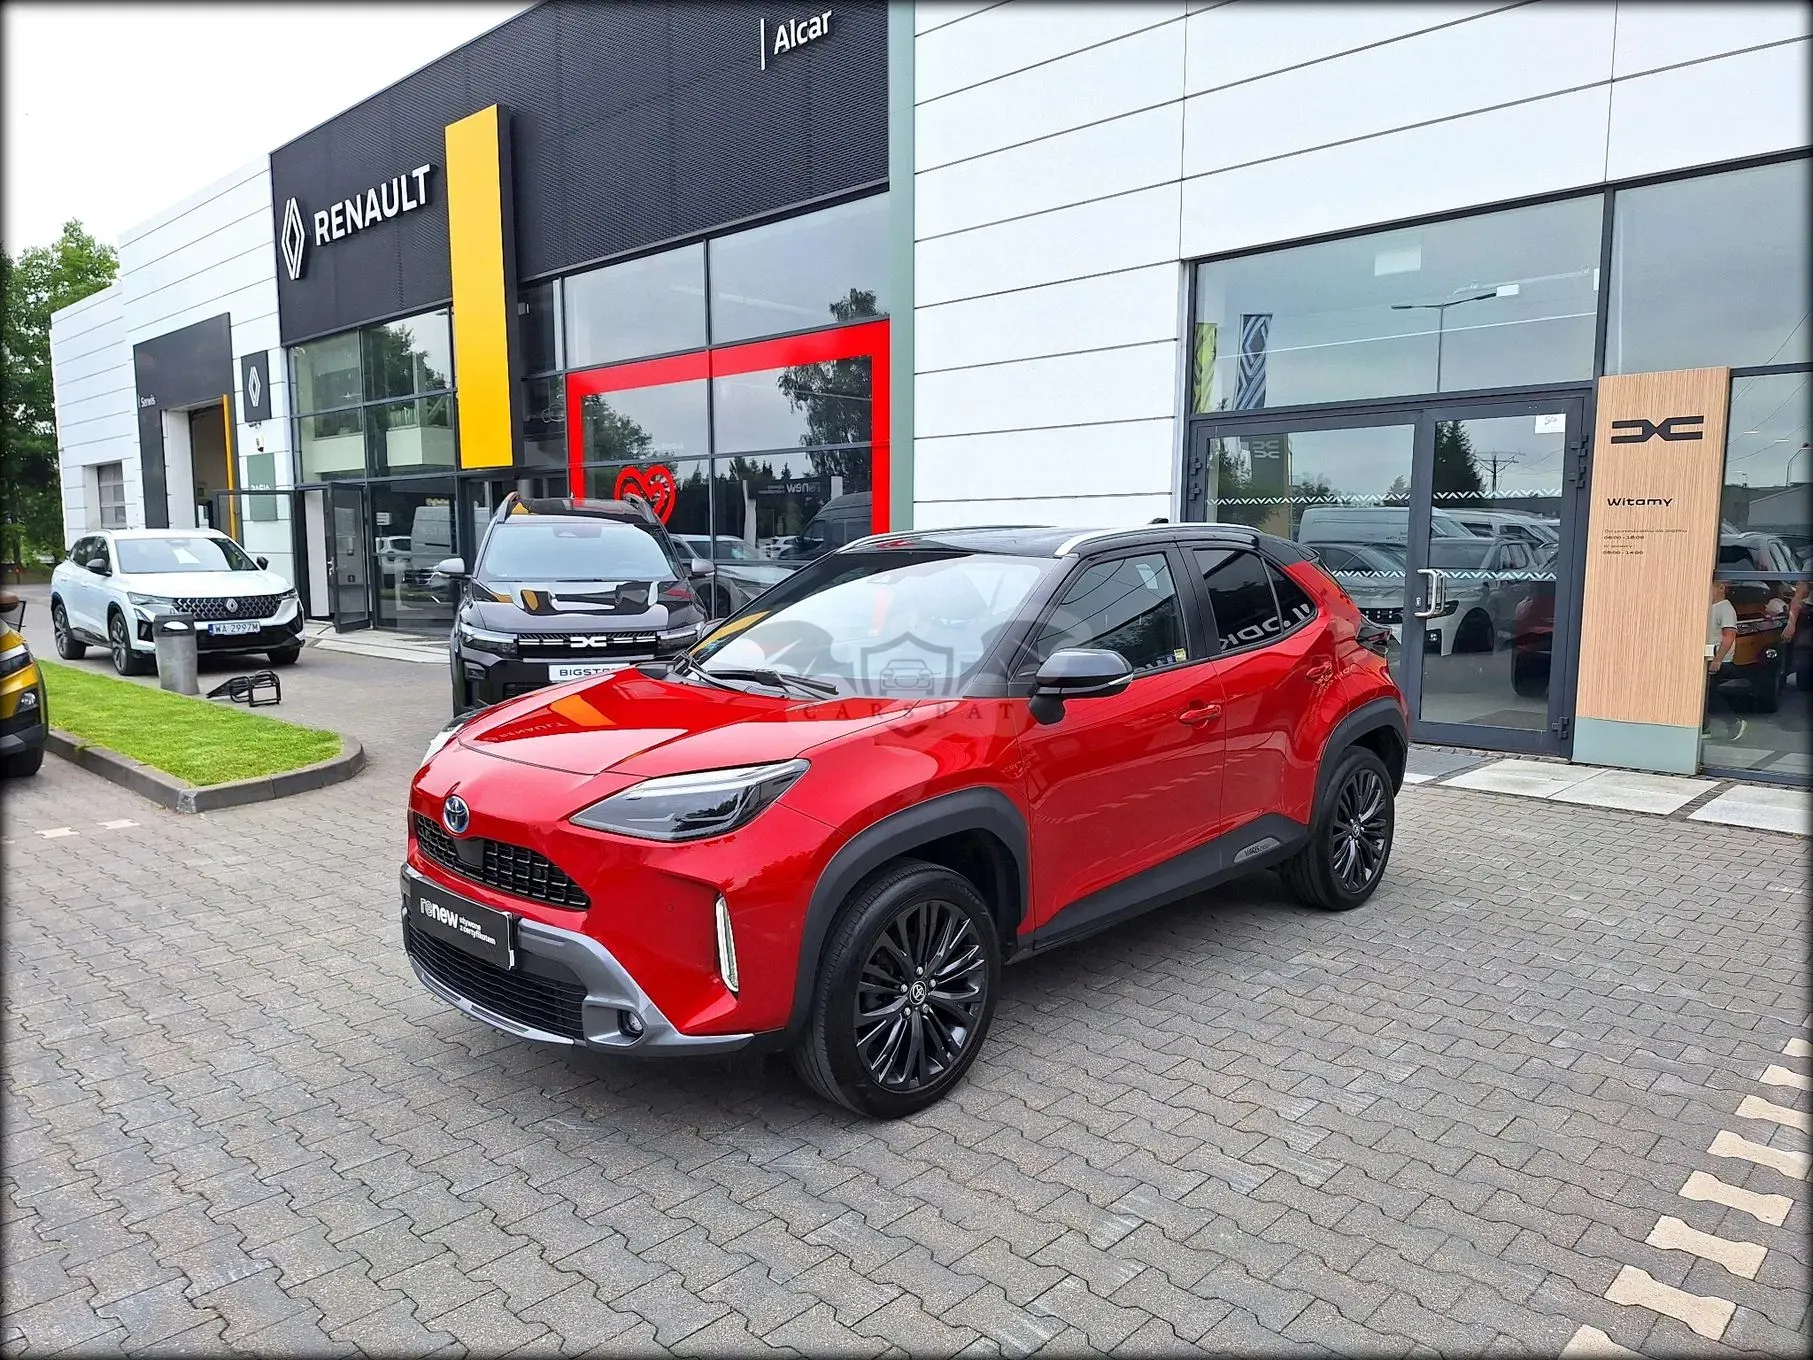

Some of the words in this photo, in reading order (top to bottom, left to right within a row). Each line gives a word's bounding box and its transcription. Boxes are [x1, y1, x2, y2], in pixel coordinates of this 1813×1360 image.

[773, 9, 832, 55] Alcar
[313, 163, 431, 246] RENAULT
[1607, 497, 1673, 507] Witamy
[420, 897, 459, 929] renew
